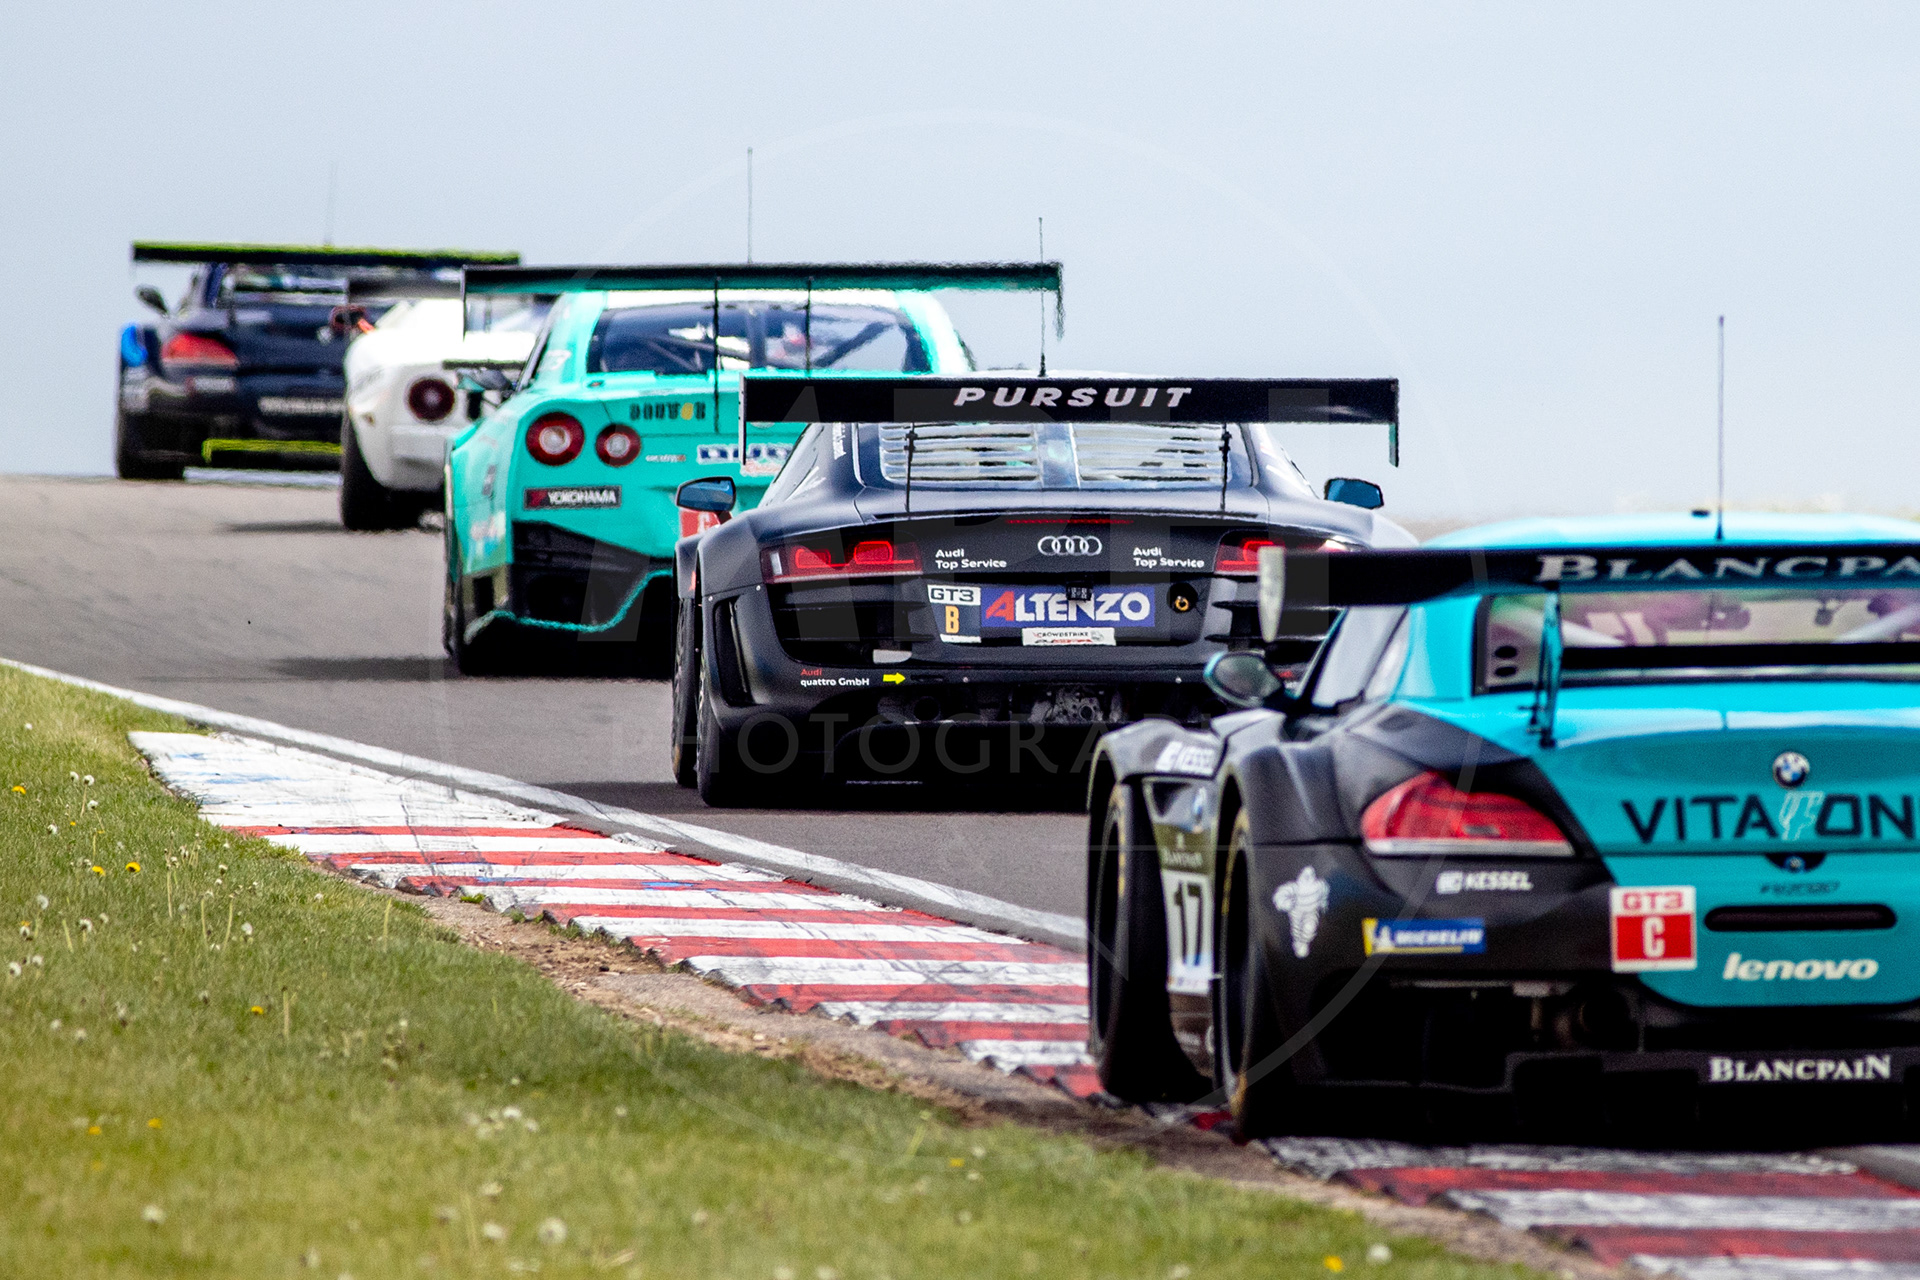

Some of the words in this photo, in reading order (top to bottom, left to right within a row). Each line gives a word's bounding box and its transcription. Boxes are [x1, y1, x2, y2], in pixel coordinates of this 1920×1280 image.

[953, 387, 1192, 407] PURSUIT
[548, 486, 617, 505] YOKOHAMA
[935, 549, 965, 558] Audi
[1133, 547, 1162, 557] Audi
[935, 560, 957, 570] Top
[961, 559, 1007, 568] Service
[1133, 558, 1156, 568] Top
[1160, 558, 1205, 568] Service
[930, 588, 974, 602] GT3
[985, 590, 1150, 622] ALTENZO
[945, 605, 959, 634] B
[801, 679, 836, 687] quattro
[838, 677, 869, 686] GmbH
[1464, 871, 1533, 891] KESSEL
[1622, 891, 1684, 911] GT3
[1174, 880, 1203, 967] 17
[1394, 929, 1484, 945] MICHELIN
[1642, 916, 1666, 959] C
[1722, 952, 1879, 981] lenovo
[1708, 1054, 1891, 1083] BLANCPAIN
